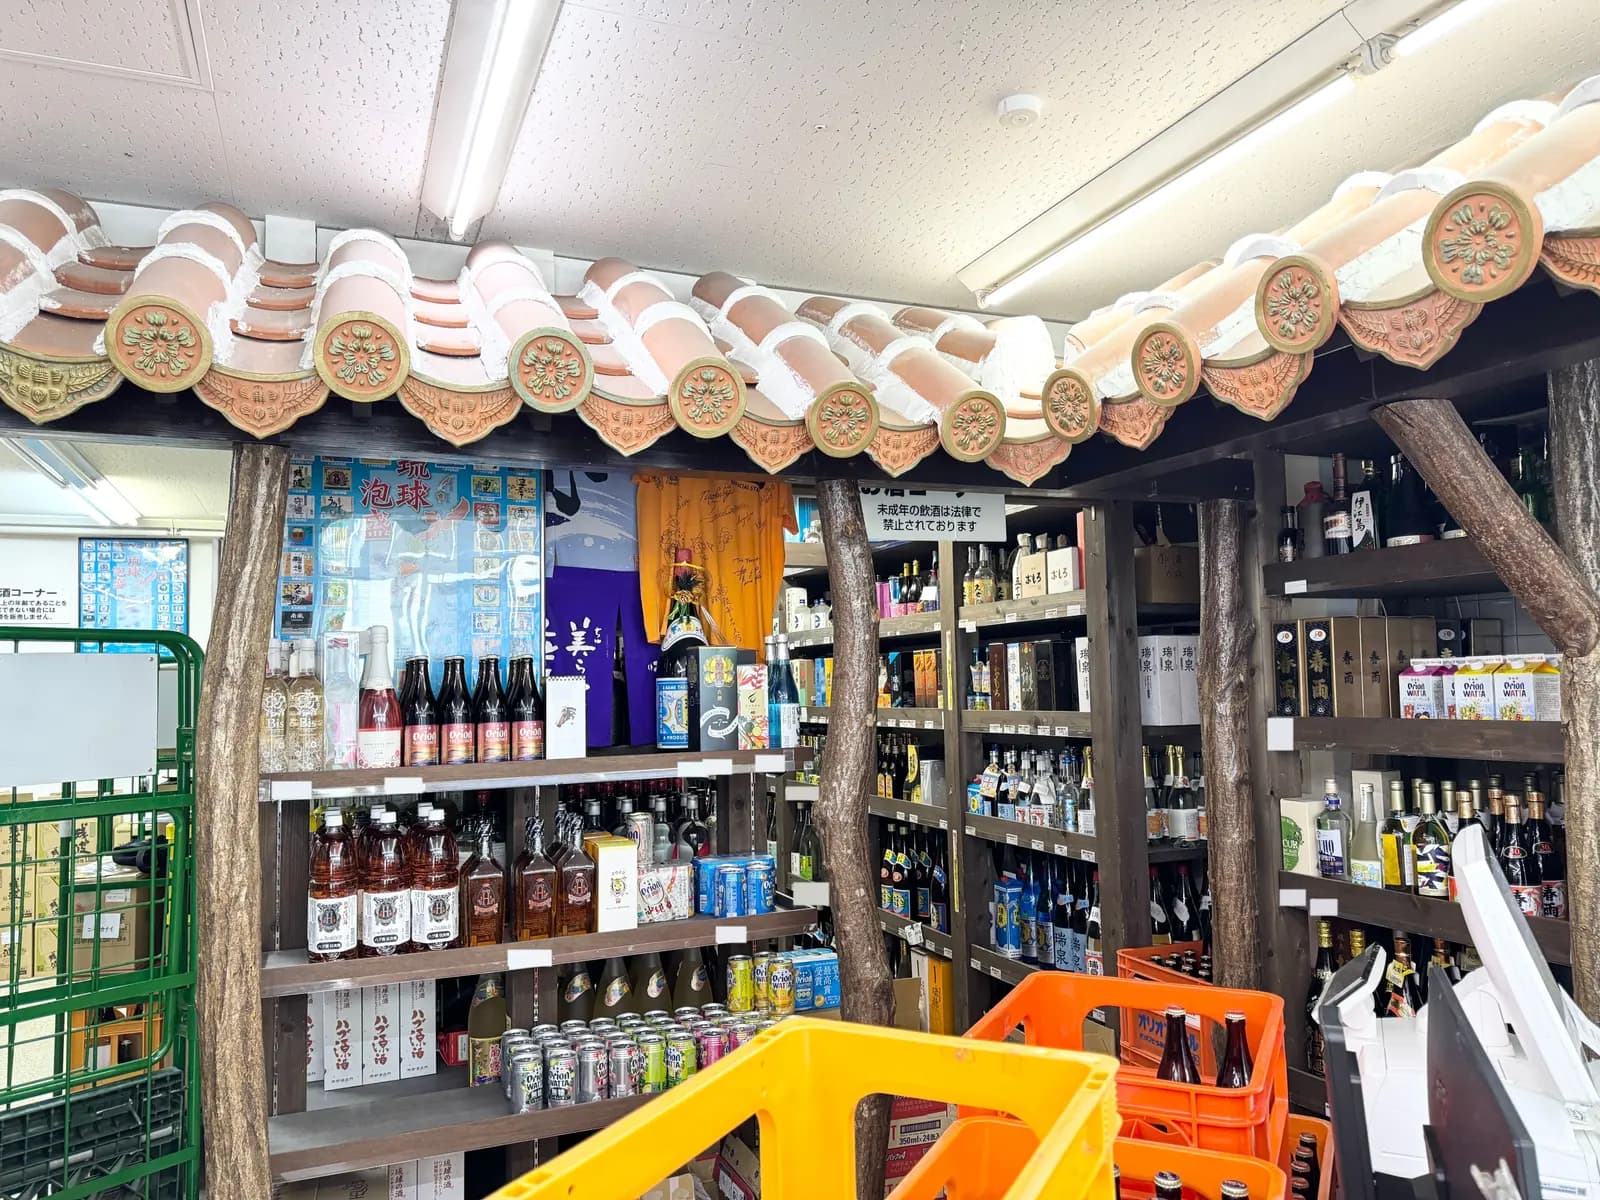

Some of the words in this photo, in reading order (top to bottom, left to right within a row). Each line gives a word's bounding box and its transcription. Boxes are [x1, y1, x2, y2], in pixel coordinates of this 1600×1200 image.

[877, 504, 981, 518] 未成年の飲酒は法律で
[883, 519, 977, 532] 禁止されております
[1162, 646, 1174, 672] 瑞泉
[1182, 646, 1195, 672] 瑞泉
[1463, 681, 1484, 690] Orion
[1503, 680, 1525, 690] Orion
[413, 731, 437, 742] Orion
[449, 729, 473, 741] Orion
[486, 728, 508, 740] Orion
[519, 727, 542, 738] Orion
[756, 968, 767, 977] Ori
[773, 974, 793, 983] Orion
